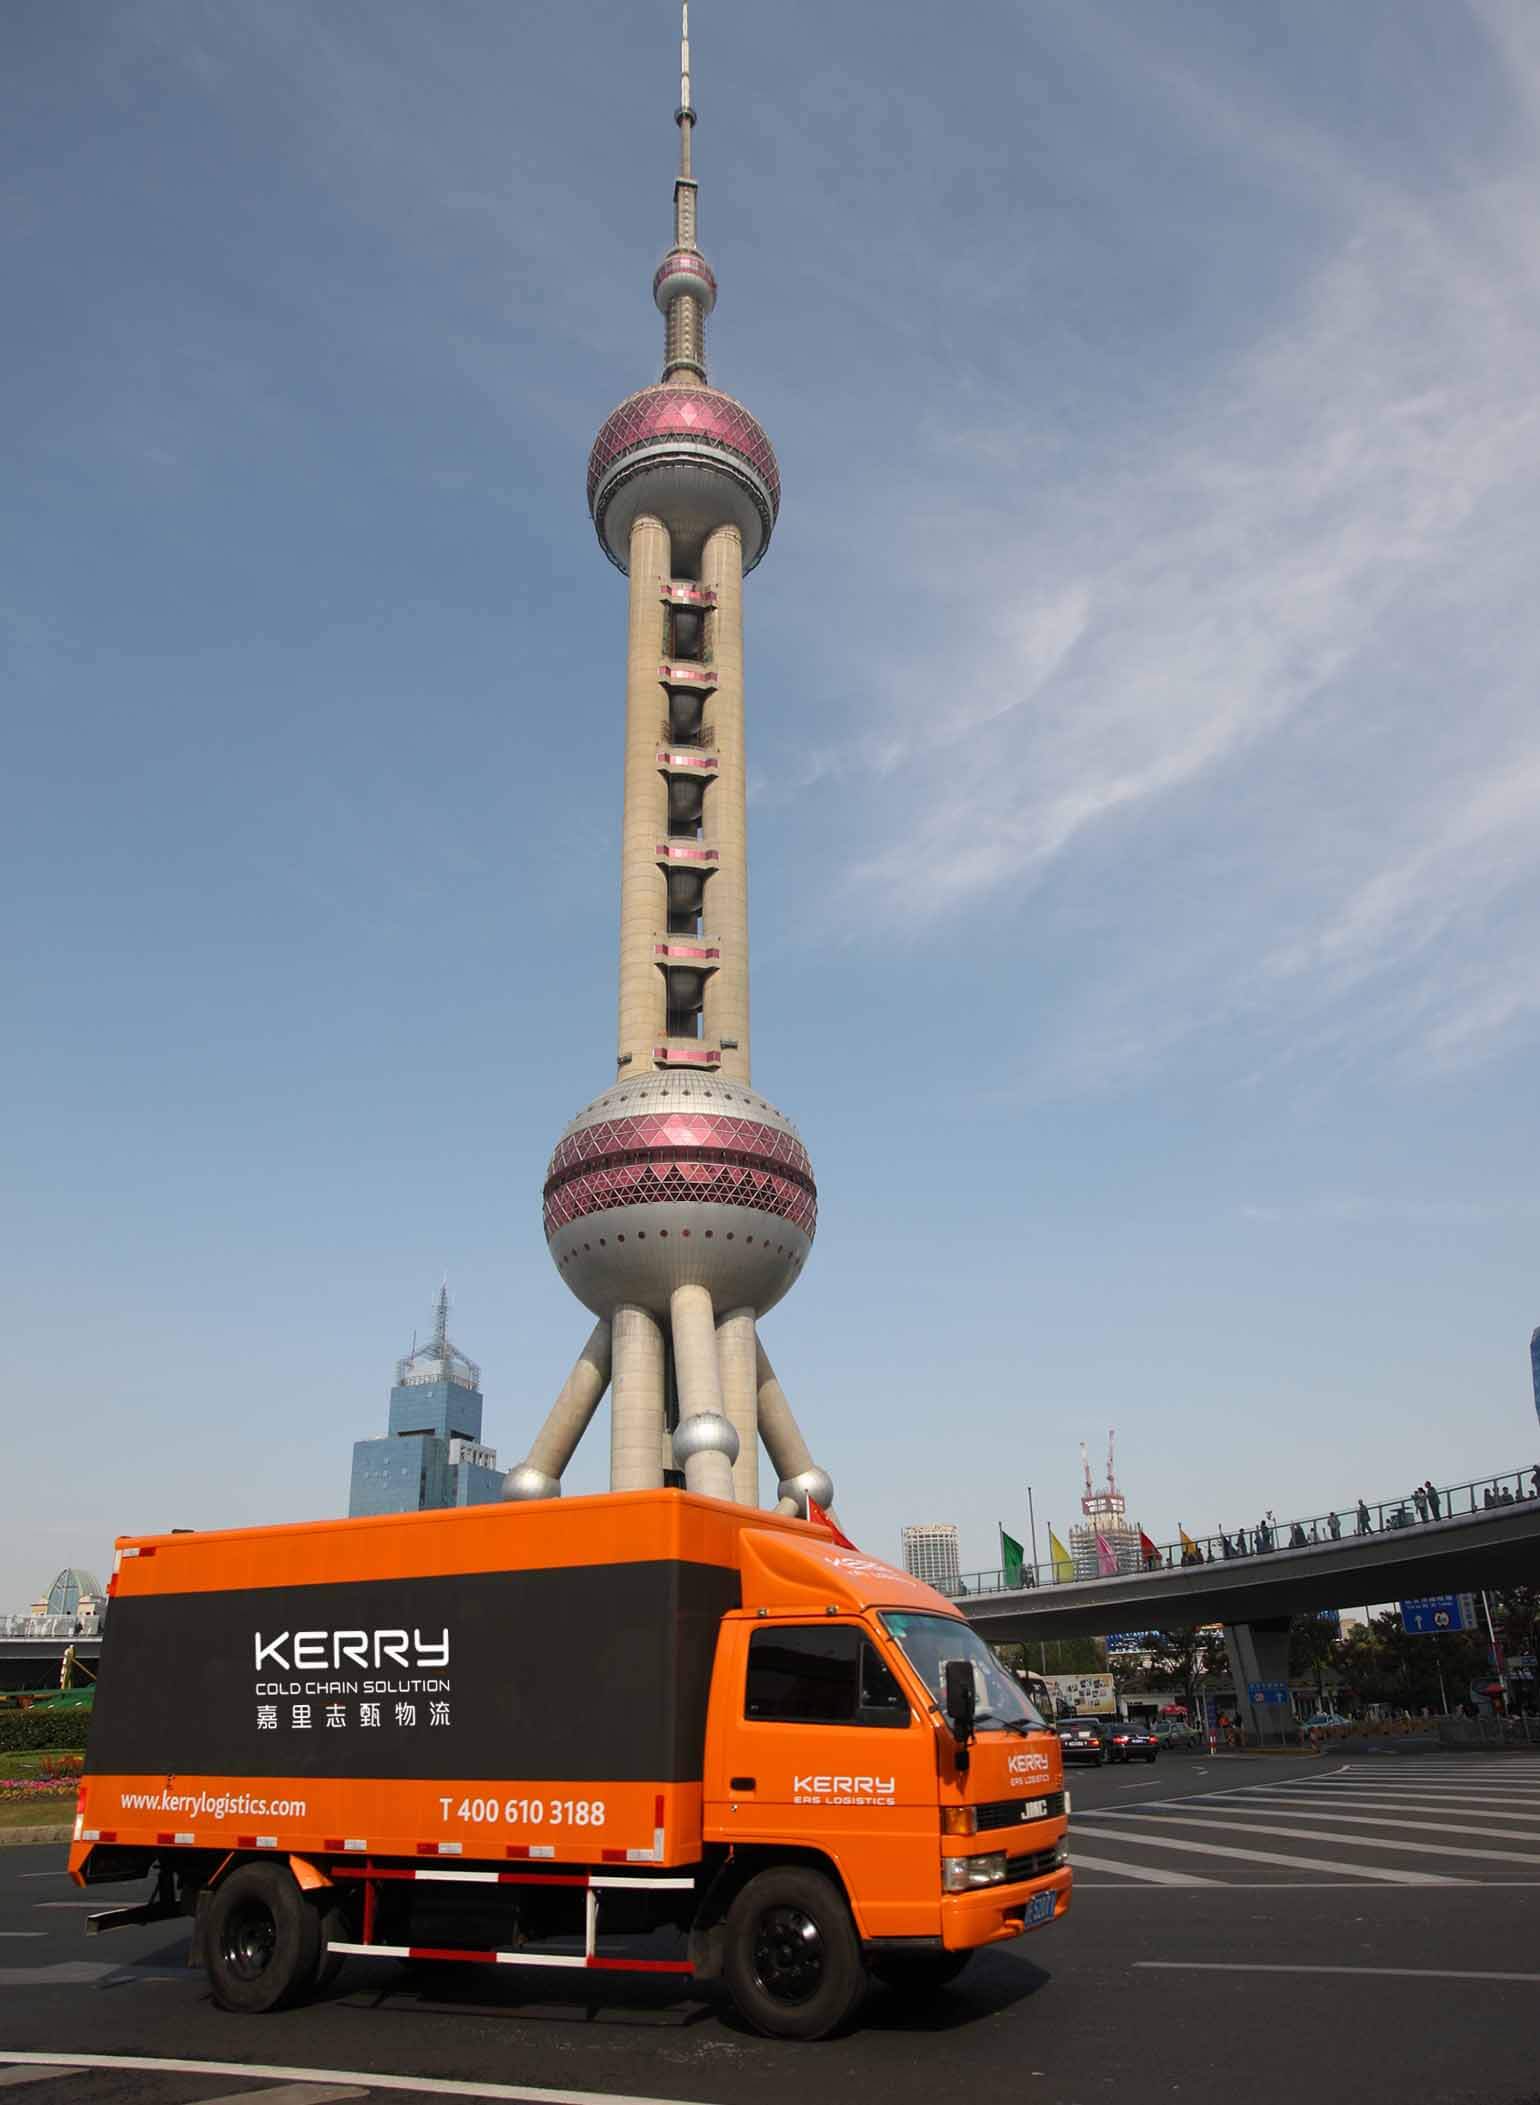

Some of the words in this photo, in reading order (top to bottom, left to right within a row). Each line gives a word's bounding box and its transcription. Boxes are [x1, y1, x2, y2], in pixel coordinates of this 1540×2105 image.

[255, 1628, 449, 1671] KERRY
[256, 1682, 301, 1696] COLD
[305, 1681, 358, 1695] CHAIN
[363, 1679, 451, 1694] SOLUTION
[1008, 1753, 1049, 1773] KERRY
[793, 1775, 895, 1794] KERRY
[121, 1789, 307, 1819] www.kerrylogistics.com
[825, 1797, 896, 1806] LOGISTICS
[440, 1798, 453, 1821] T
[457, 1798, 499, 1823] 400
[505, 1799, 544, 1824] 610
[550, 1800, 606, 1826] 3188
